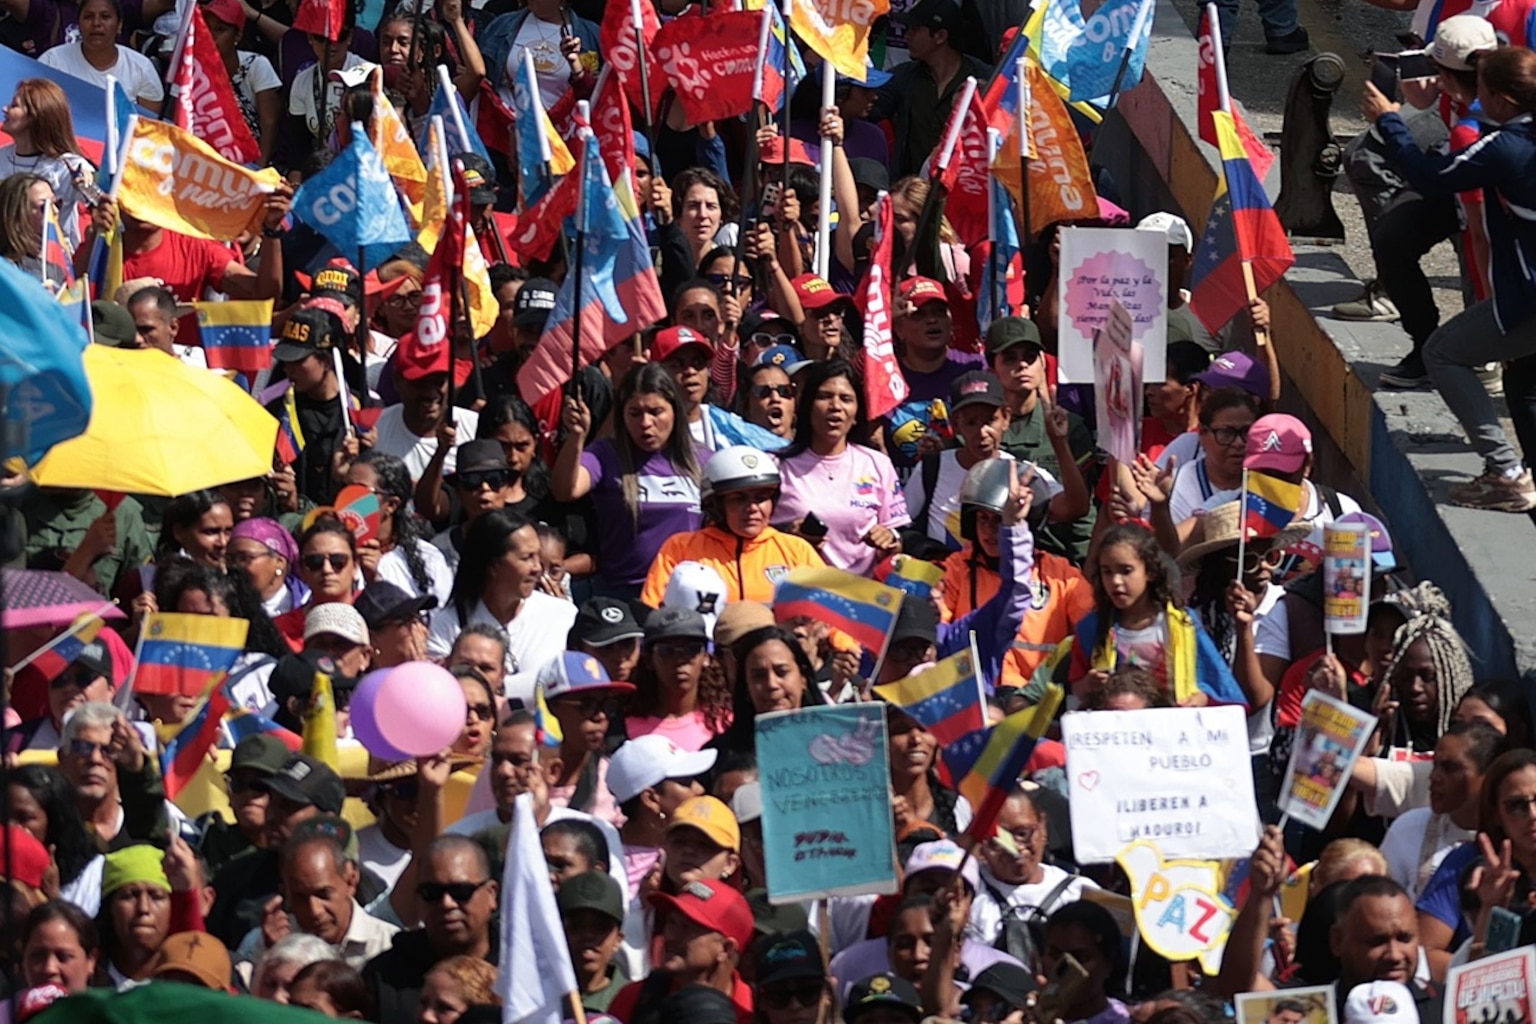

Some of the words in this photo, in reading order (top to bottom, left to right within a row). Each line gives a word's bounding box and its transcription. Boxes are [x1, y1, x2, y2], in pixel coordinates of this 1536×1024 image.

[1100, 275, 1110, 285] la
[1142, 275, 1152, 285] la
[1178, 731, 1189, 744] A
[1148, 754, 1213, 771] PUEBLO
[1198, 796, 1209, 808] A
[1140, 872, 1219, 944] PAZ
